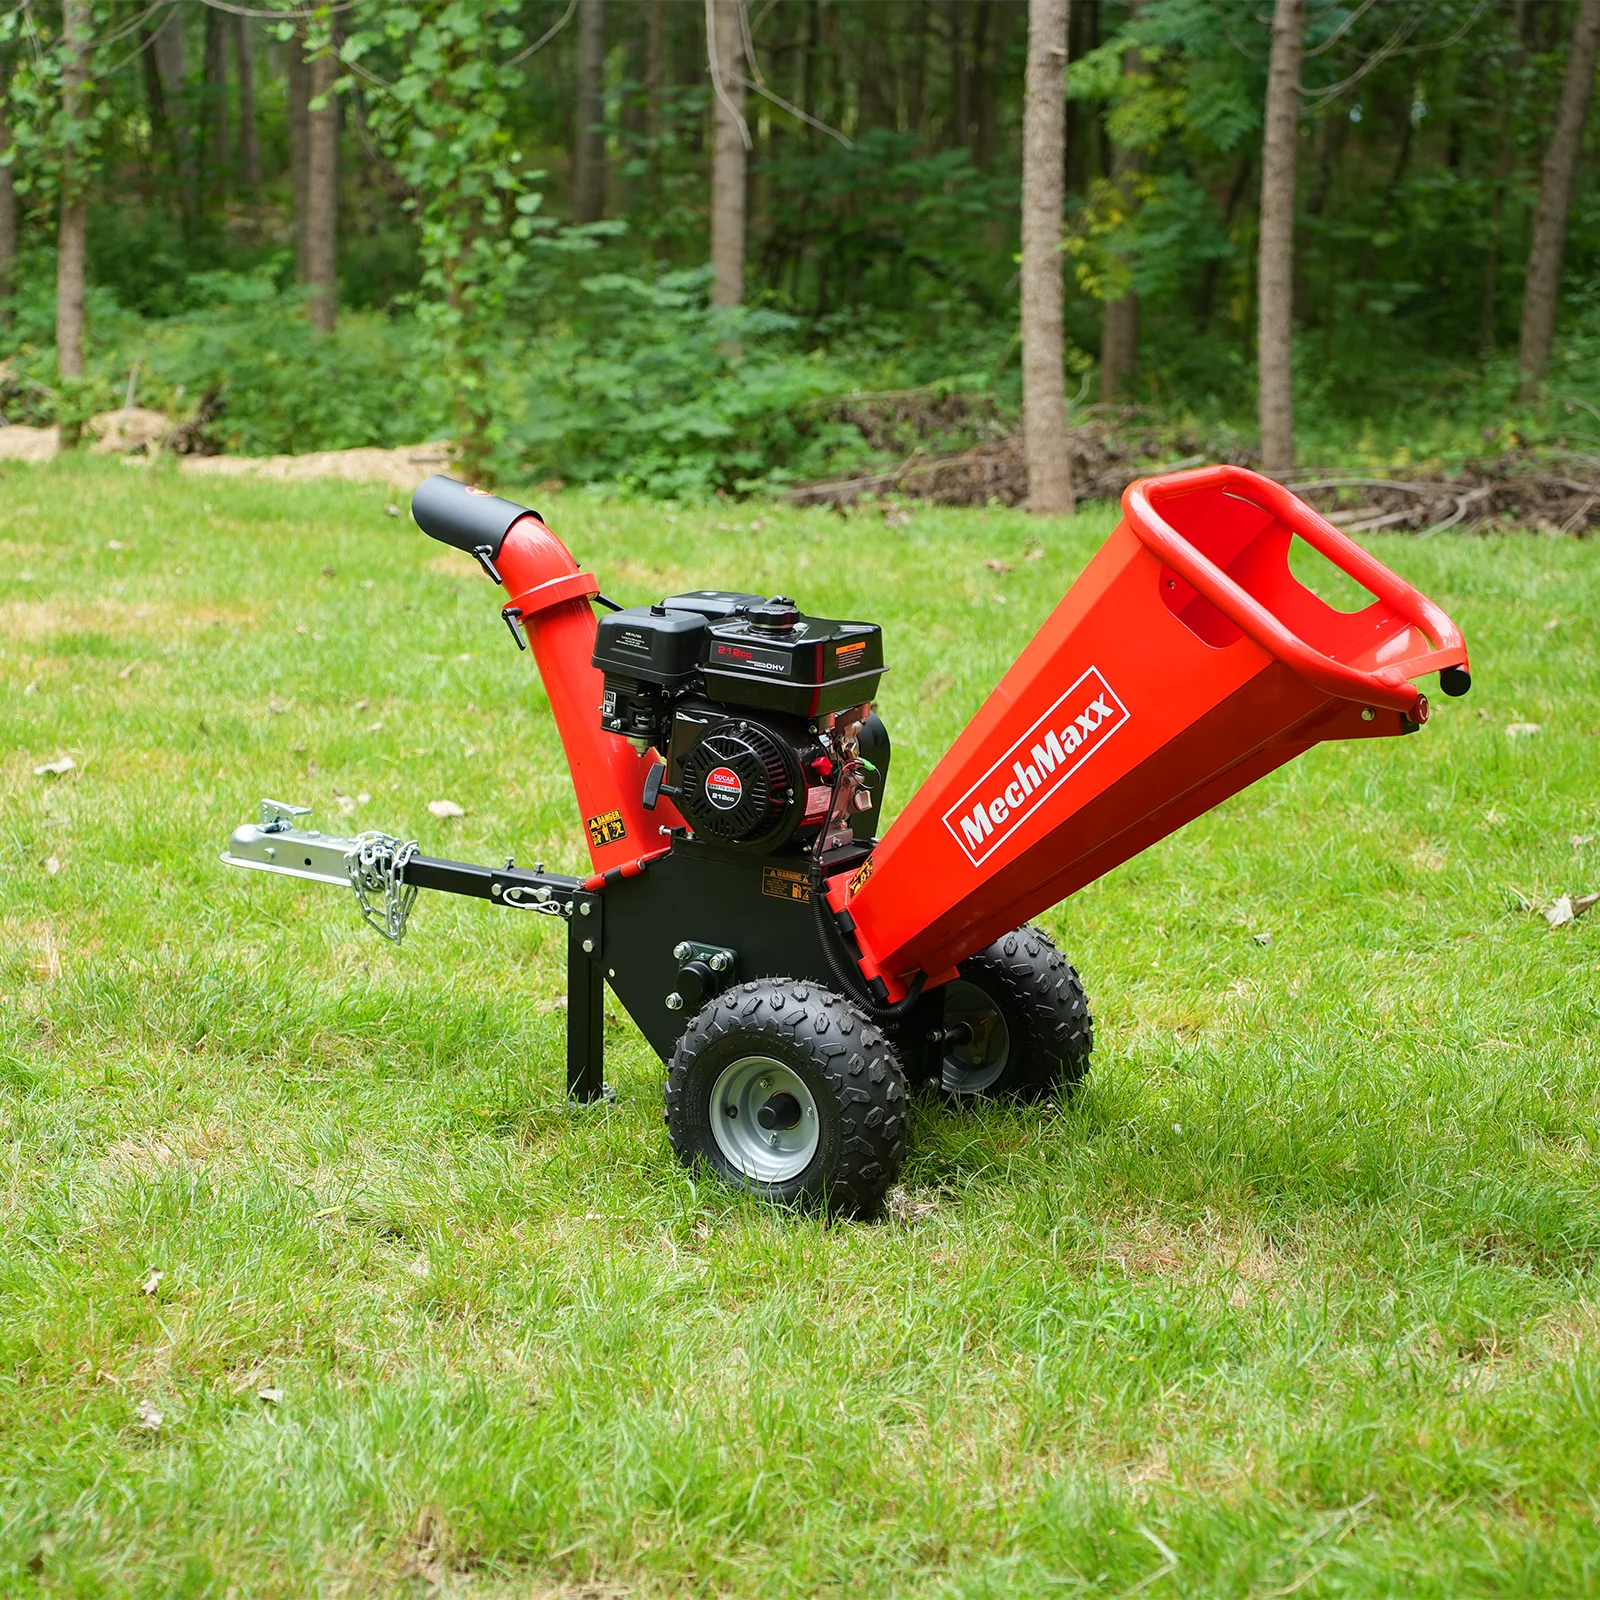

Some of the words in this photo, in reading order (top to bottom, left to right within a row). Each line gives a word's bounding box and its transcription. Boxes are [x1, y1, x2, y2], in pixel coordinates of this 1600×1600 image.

[717, 645, 753, 660] 212cc
[766, 662, 785, 672] OHV
[959, 692, 1115, 851] MechMaxx
[712, 792, 735, 802] 212cc
[597, 810, 620, 825] DANGER
[777, 870, 802, 882] WARNING
